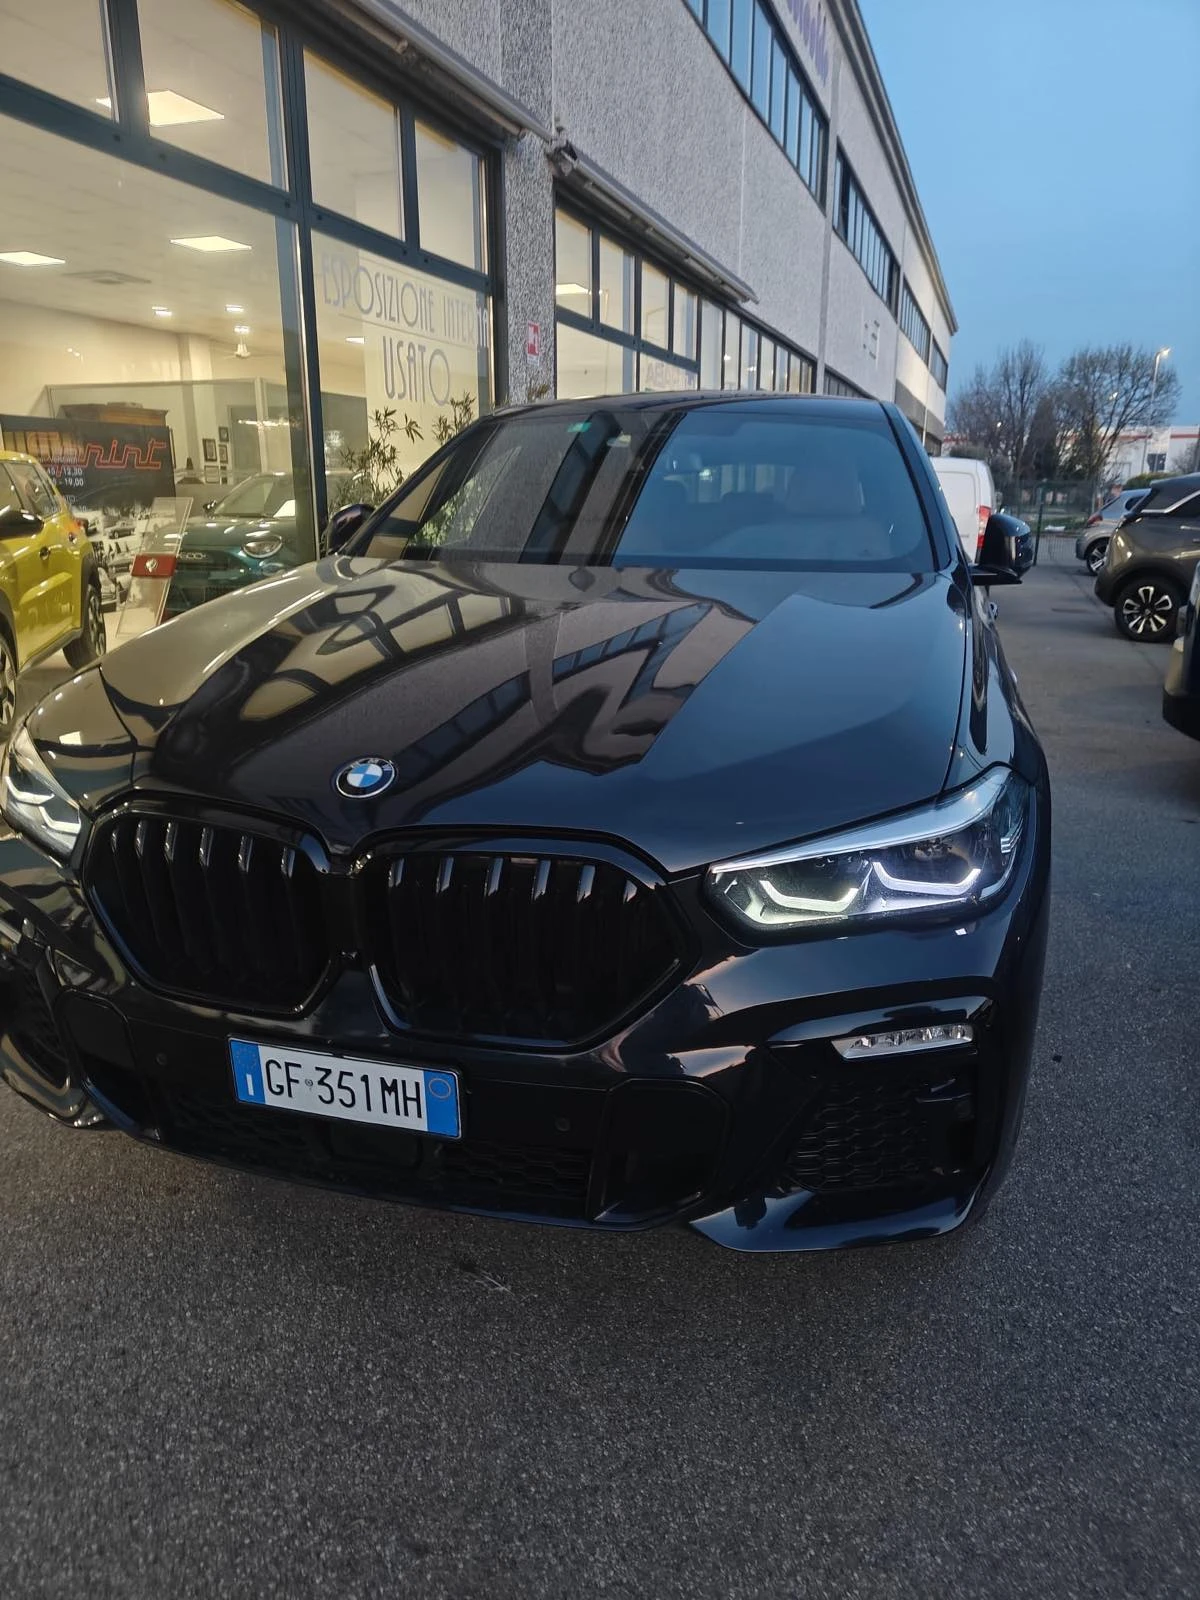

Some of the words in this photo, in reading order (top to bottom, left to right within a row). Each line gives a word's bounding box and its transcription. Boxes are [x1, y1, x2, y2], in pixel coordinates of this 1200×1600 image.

[321, 252, 435, 333] ESPOSIZIONE
[382, 335, 451, 406] USATO
[64, 477, 84, 488] 19,00
[265, 1058, 302, 1099] GF
[314, 1066, 423, 1119] 351MH
